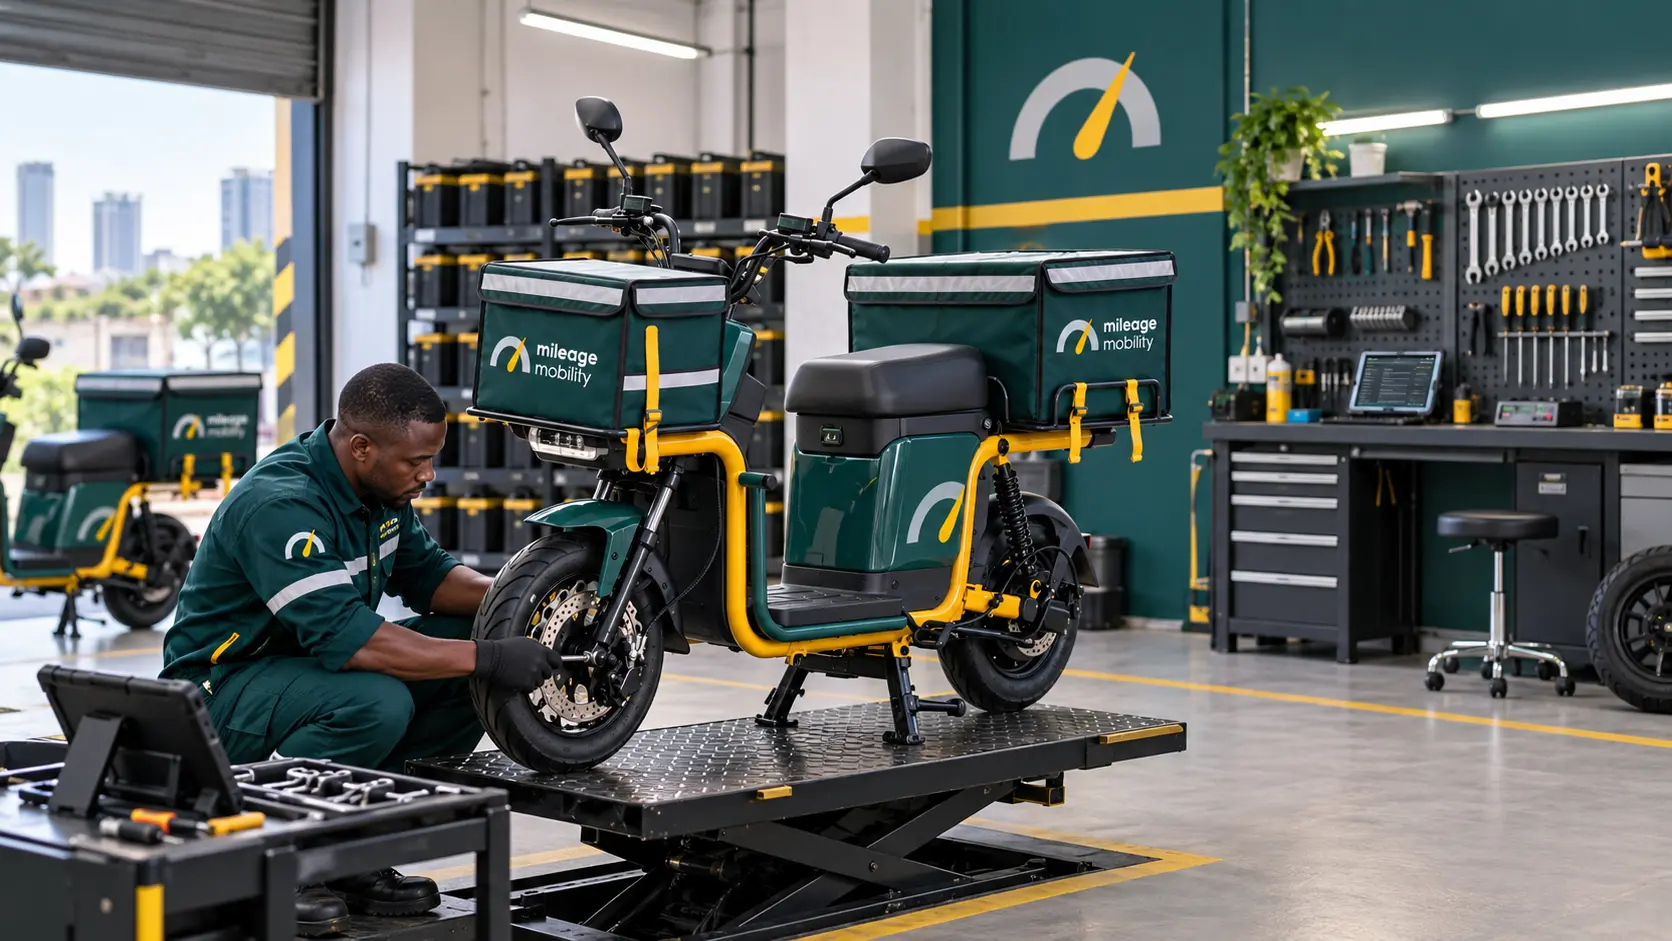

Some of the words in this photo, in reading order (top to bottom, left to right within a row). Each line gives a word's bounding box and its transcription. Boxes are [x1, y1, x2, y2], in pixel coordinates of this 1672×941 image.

[1103, 317, 1158, 334] mileage
[1103, 335, 1154, 352] mobility
[536, 343, 598, 367] mileage
[534, 364, 592, 388] mobility
